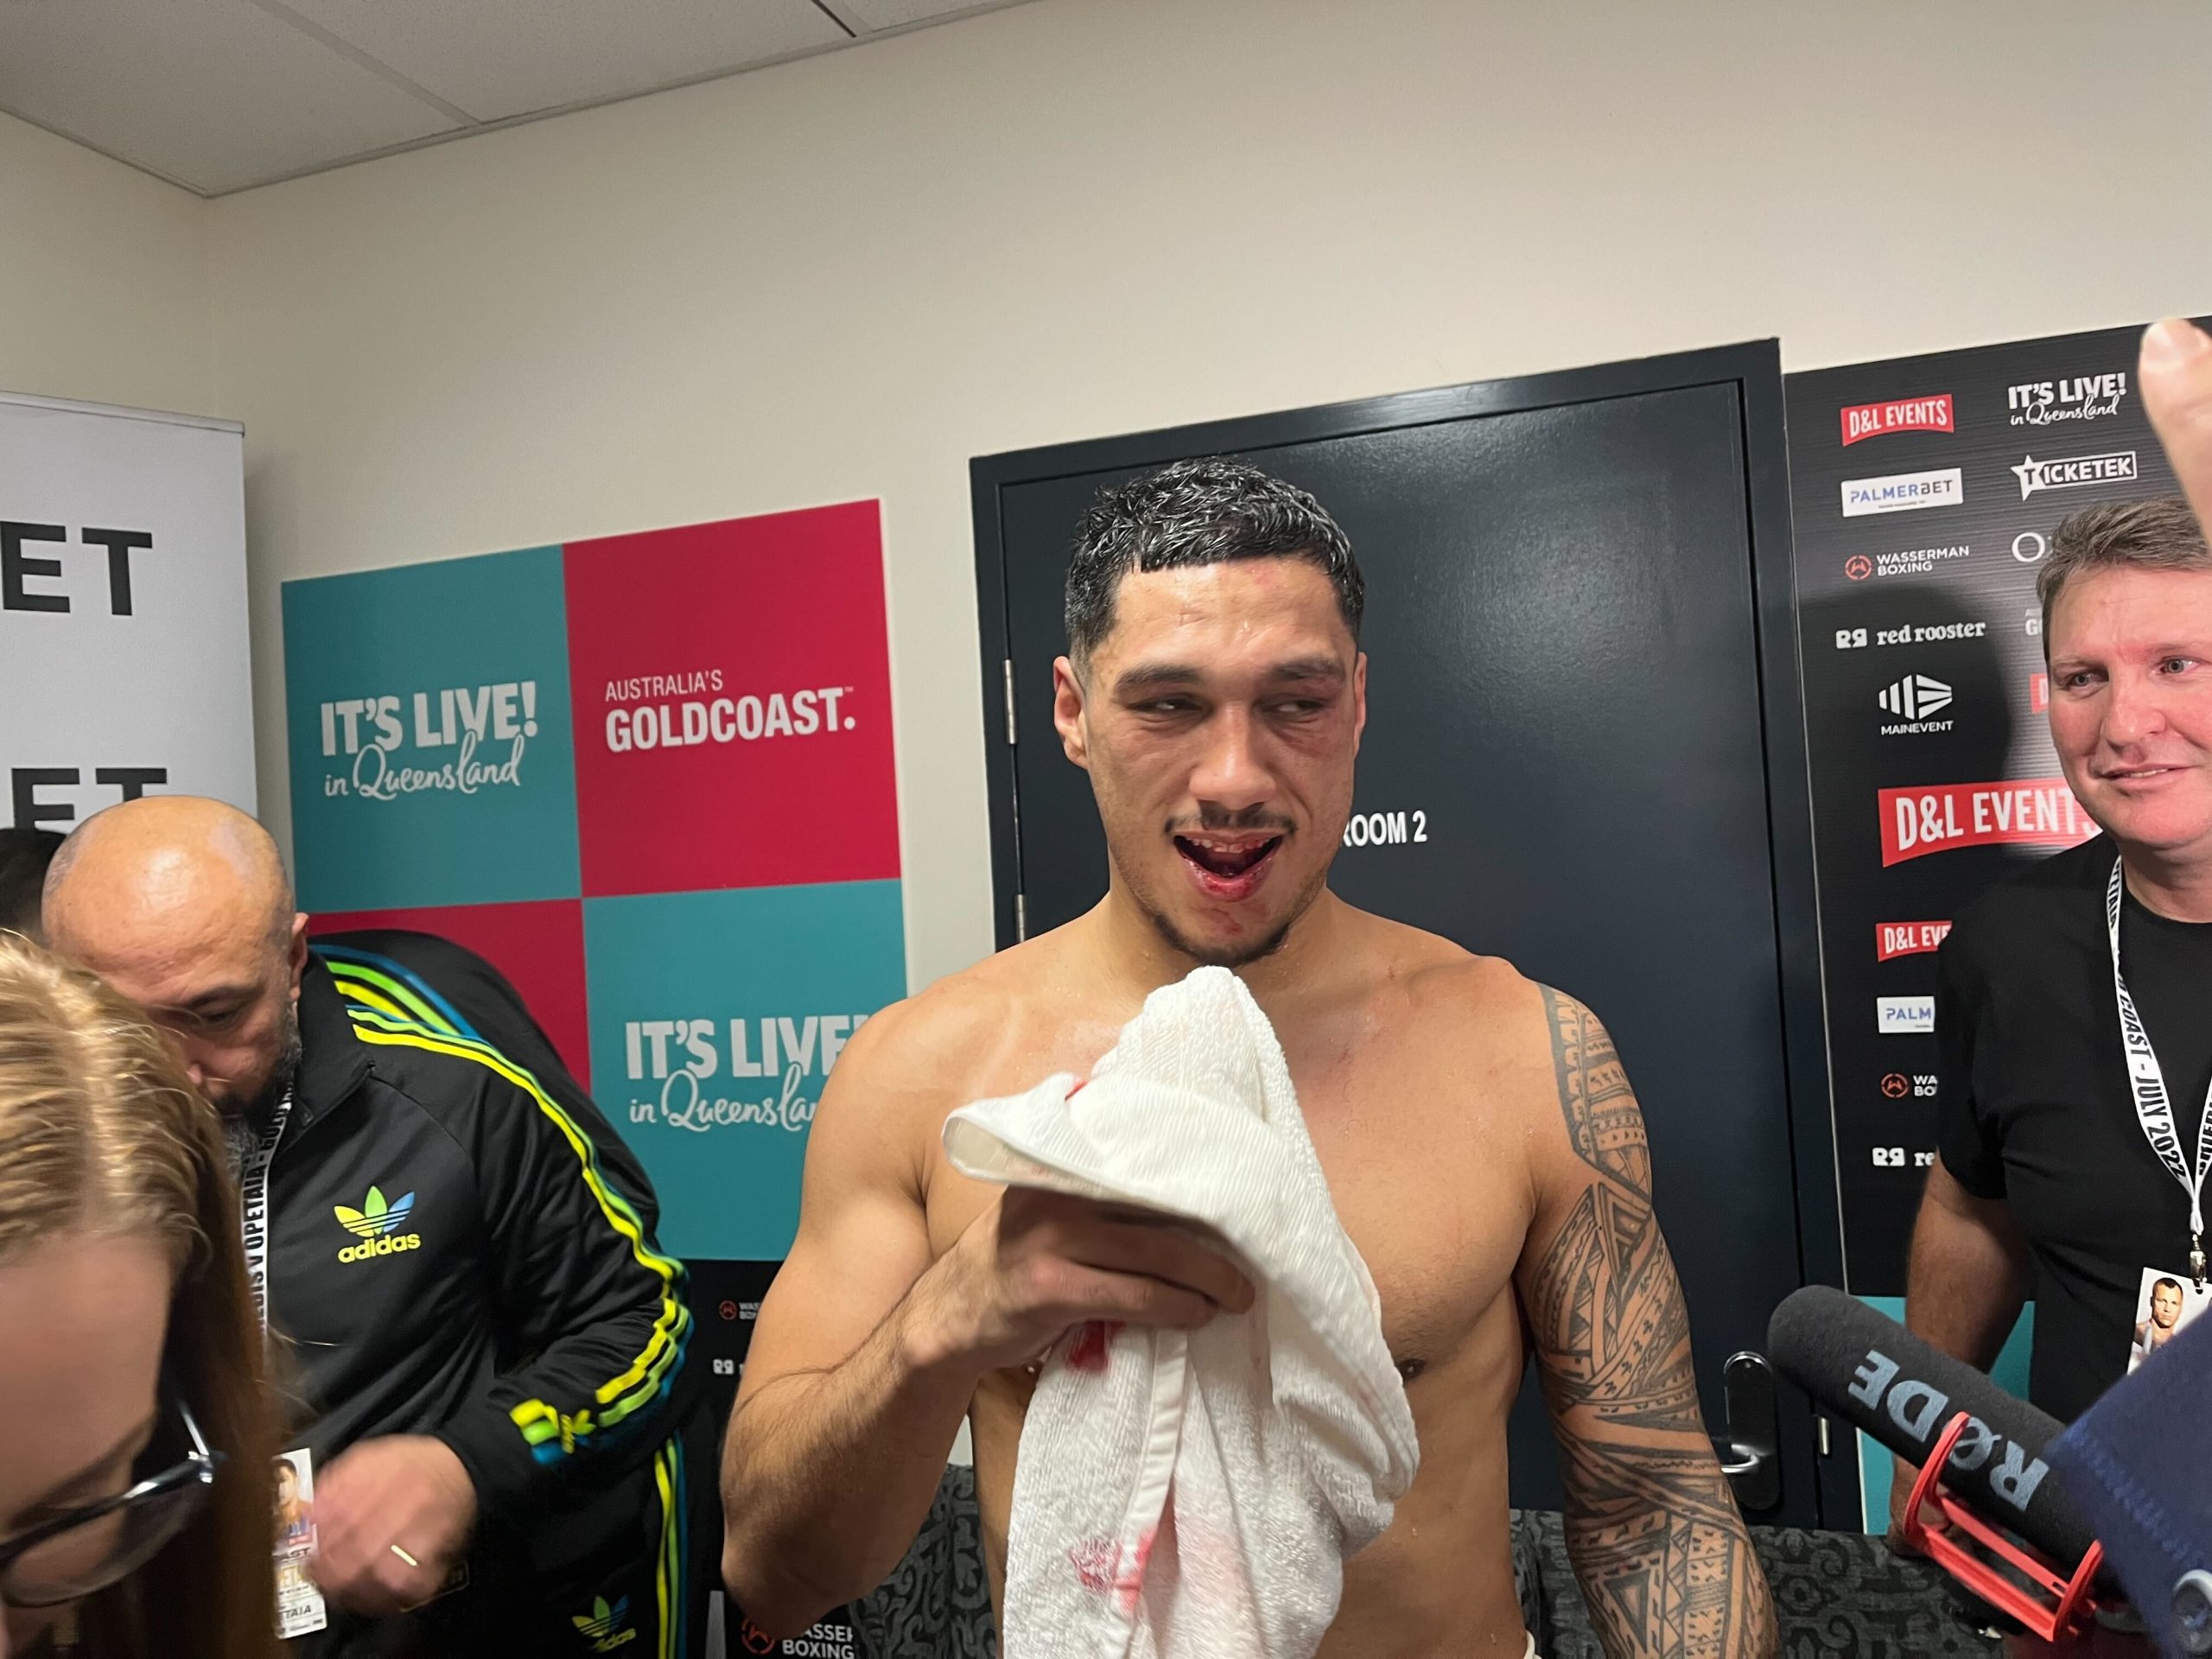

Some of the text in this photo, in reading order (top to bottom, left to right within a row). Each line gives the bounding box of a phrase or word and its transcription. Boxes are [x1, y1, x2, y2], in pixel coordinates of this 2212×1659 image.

[2008, 372, 2126, 410] IT'S LIVE!
[1849, 399, 1948, 438] D&L EVENTS
[2010, 392, 2120, 425] in Queensland
[1850, 480, 1953, 503] PALMERBET
[1876, 546, 1969, 565] WASSERMAN
[1878, 562, 1933, 576] BOXING
[1877, 624, 1911, 645] red
[1914, 621, 1986, 642] rooster
[605, 669, 723, 702] AUSTRALIA'S
[321, 681, 537, 756] IT'S LIVE!
[1880, 721, 1954, 735] MAINEVENT
[324, 731, 525, 800] in Queensland
[1412, 810, 1427, 842] 2
[1896, 795, 1964, 851] D&L
[1885, 926, 1917, 954] D&L
[2120, 994, 2152, 1059] COAST
[626, 1019, 718, 1079] IT'S
[629, 1099, 657, 1123] in
[2135, 1076, 2168, 1117] JULY
[243, 1164, 267, 1249] OPETAIA
[338, 1234, 421, 1263] adidas
[782, 1639, 855, 1659] BOXING
